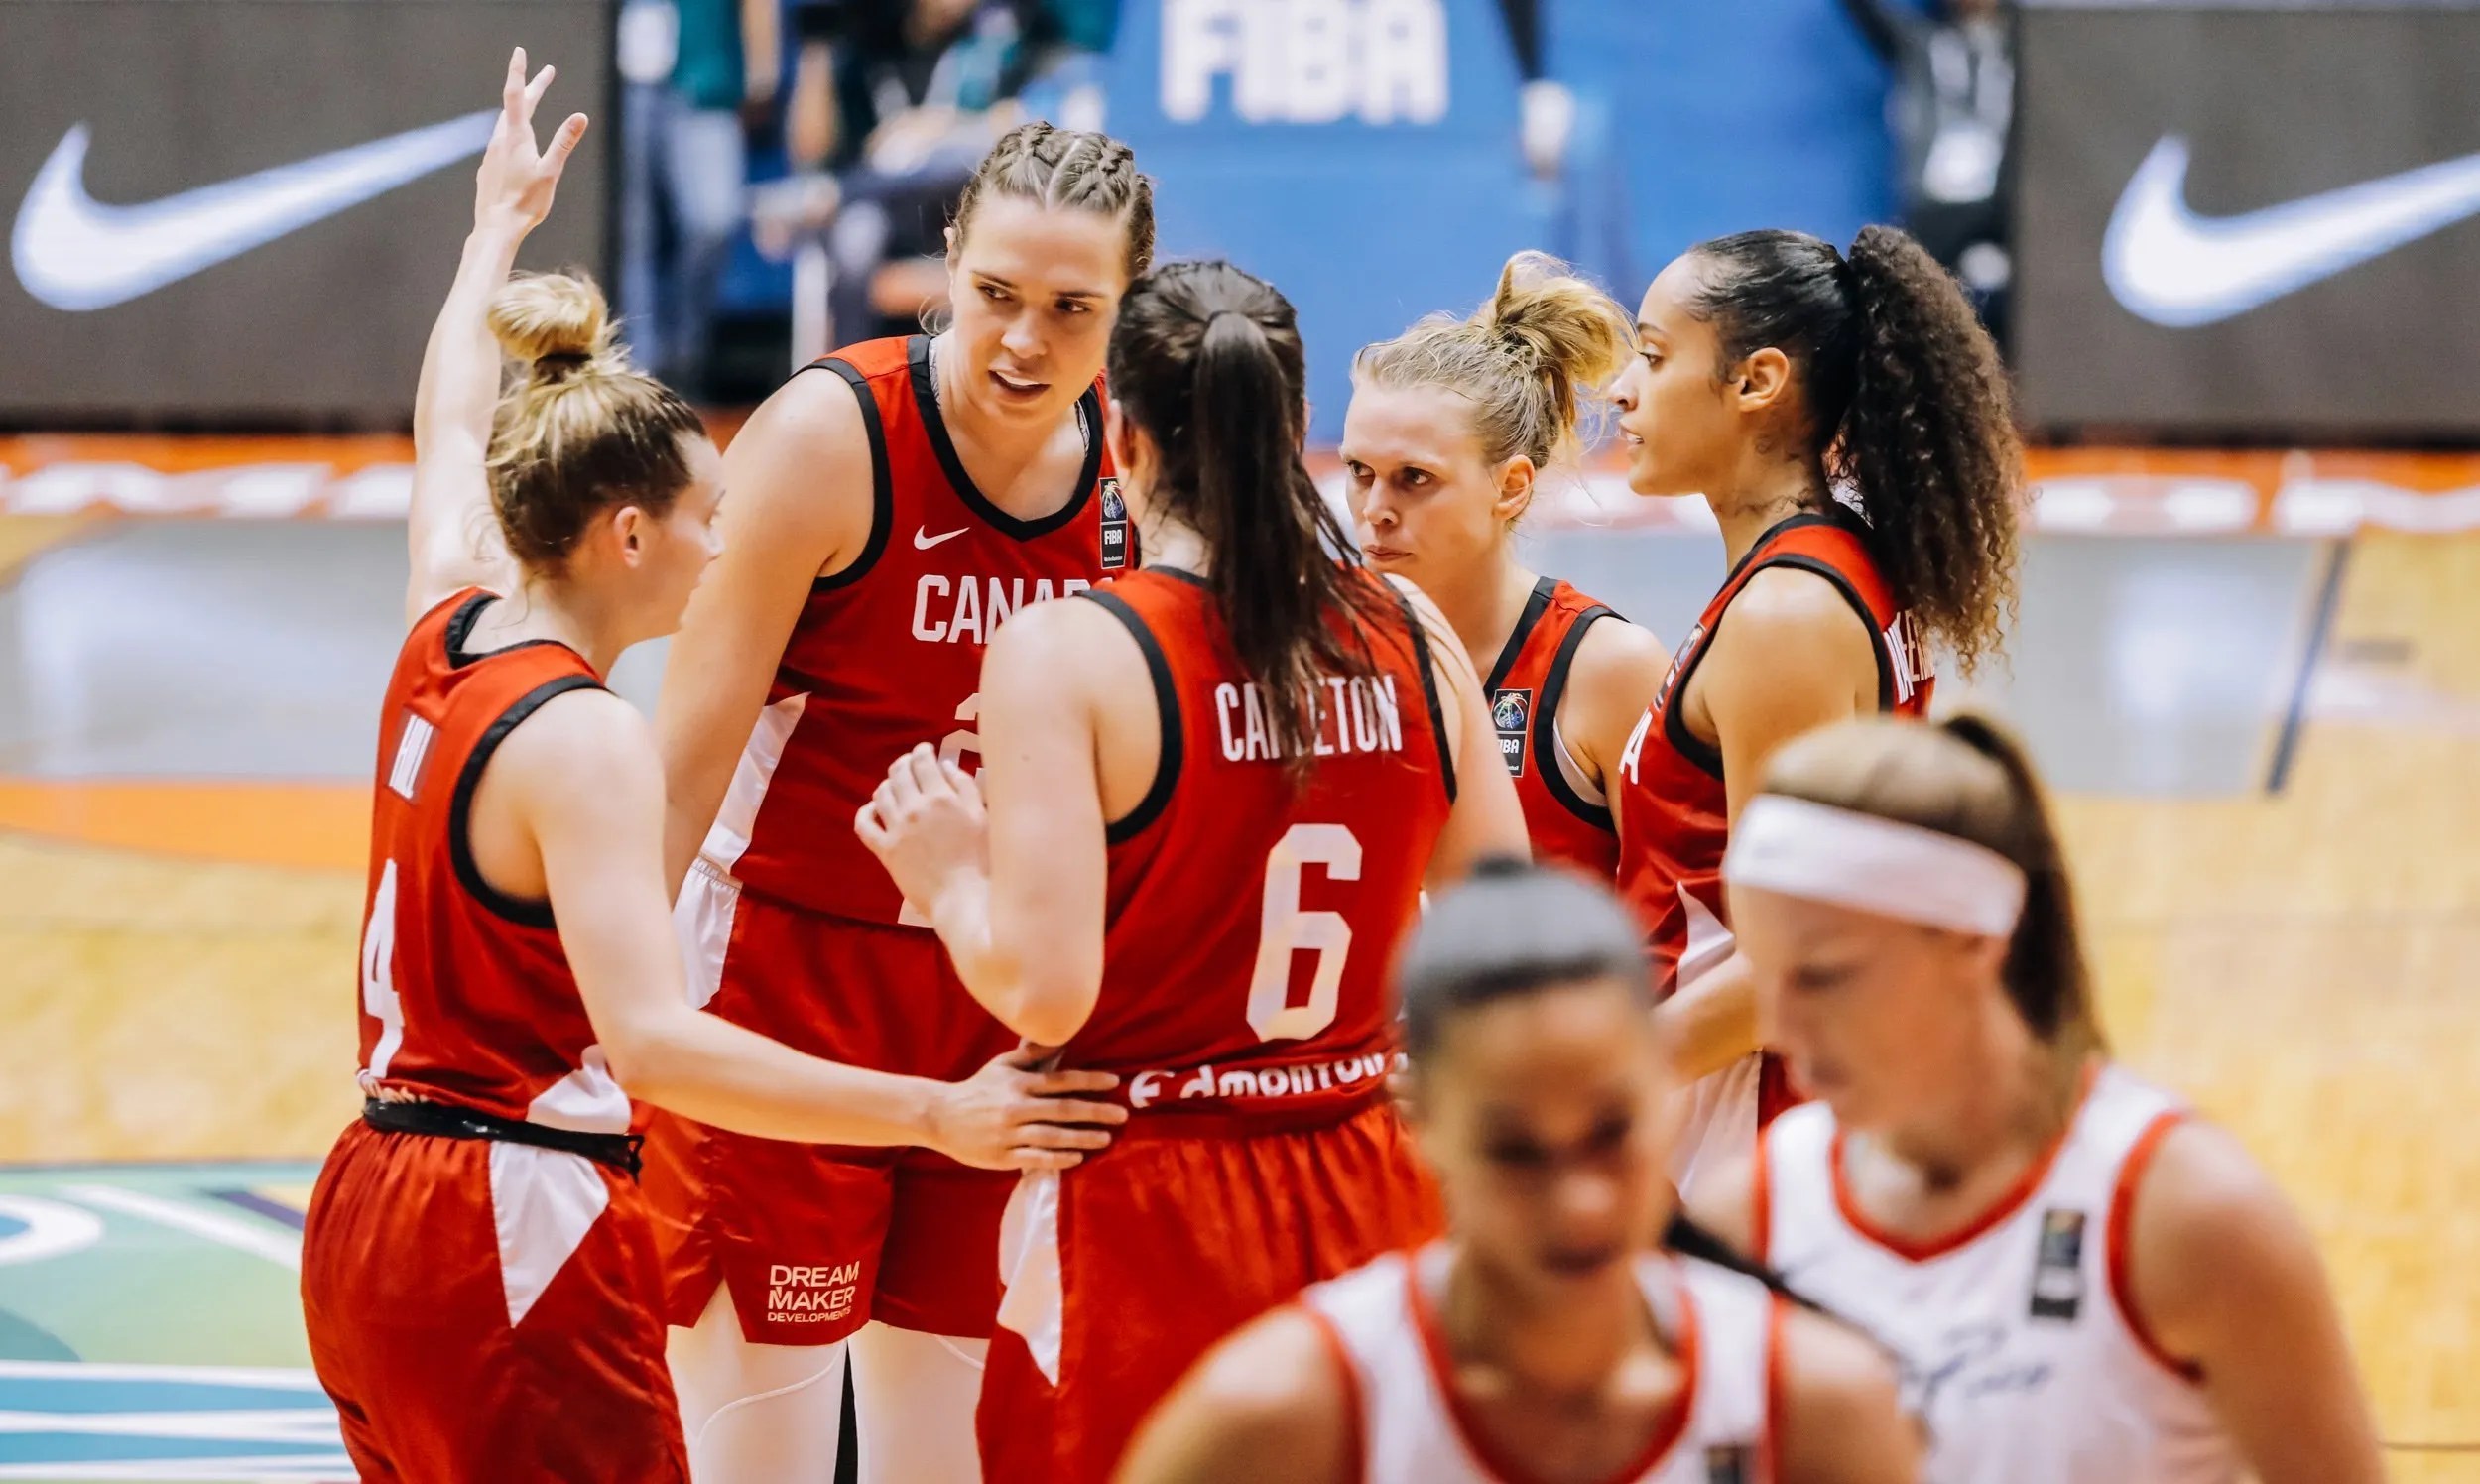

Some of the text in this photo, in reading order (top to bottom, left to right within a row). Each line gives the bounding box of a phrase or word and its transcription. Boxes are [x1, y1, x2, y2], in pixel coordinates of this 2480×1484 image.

[1160, 0, 1450, 125] FIBA
[1103, 529, 1123, 545] FIBA
[912, 574, 1114, 646] CAN
[362, 858, 405, 1079] 4
[1246, 823, 1363, 1043] 6
[768, 1286, 855, 1310] MAKER
[770, 1261, 860, 1287] DREAM
